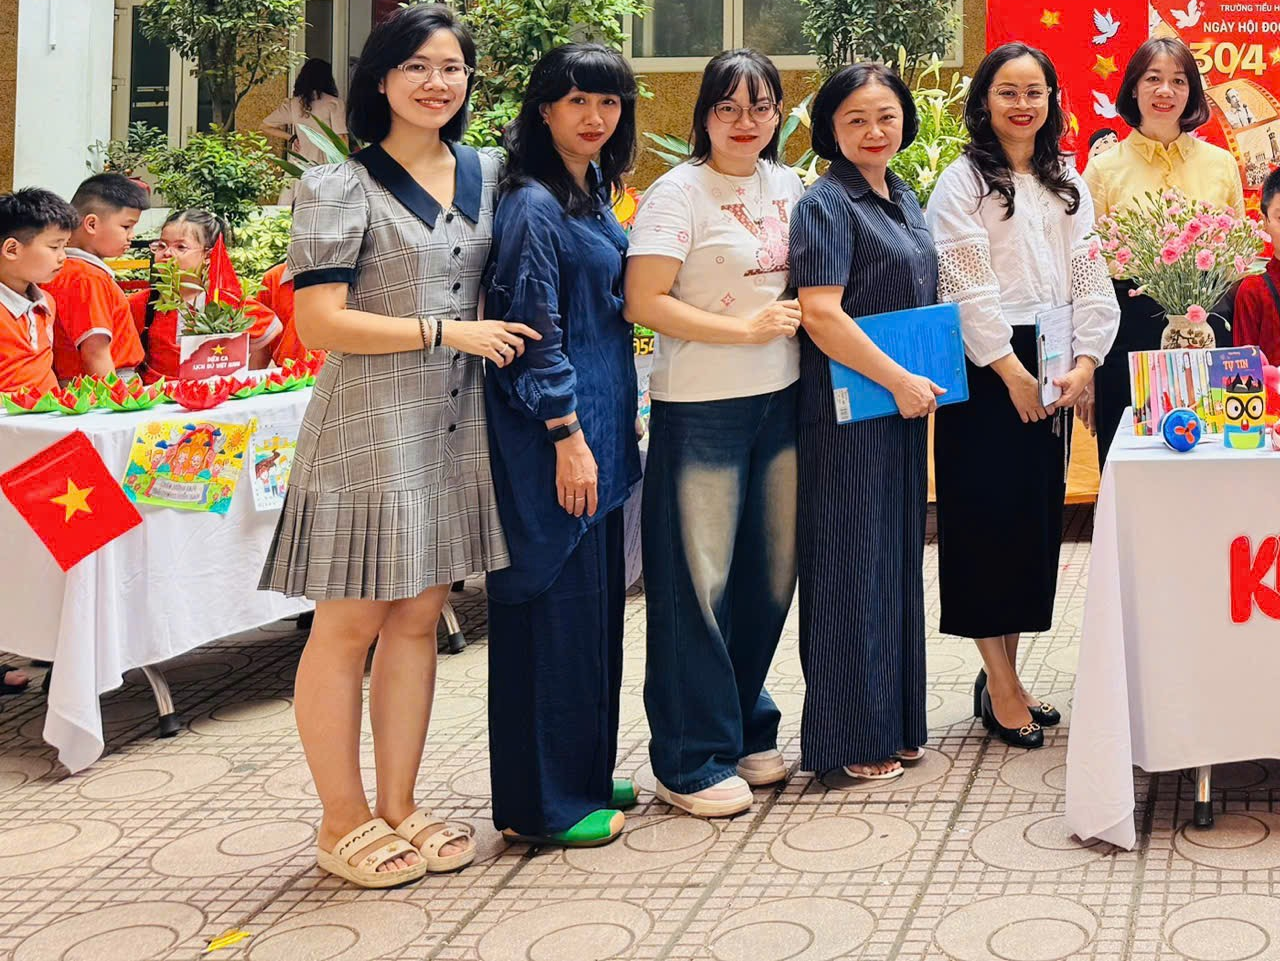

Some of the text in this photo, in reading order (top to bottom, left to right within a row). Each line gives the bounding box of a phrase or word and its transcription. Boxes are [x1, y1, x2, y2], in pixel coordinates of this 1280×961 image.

[1221, 3, 1254, 12] TRƯỜNG
[1255, 2, 1273, 12] TIỂU
[1203, 19, 1234, 33] NGÀY
[1238, 19, 1258, 34] HỘI
[1190, 41, 1267, 78] 30/4
